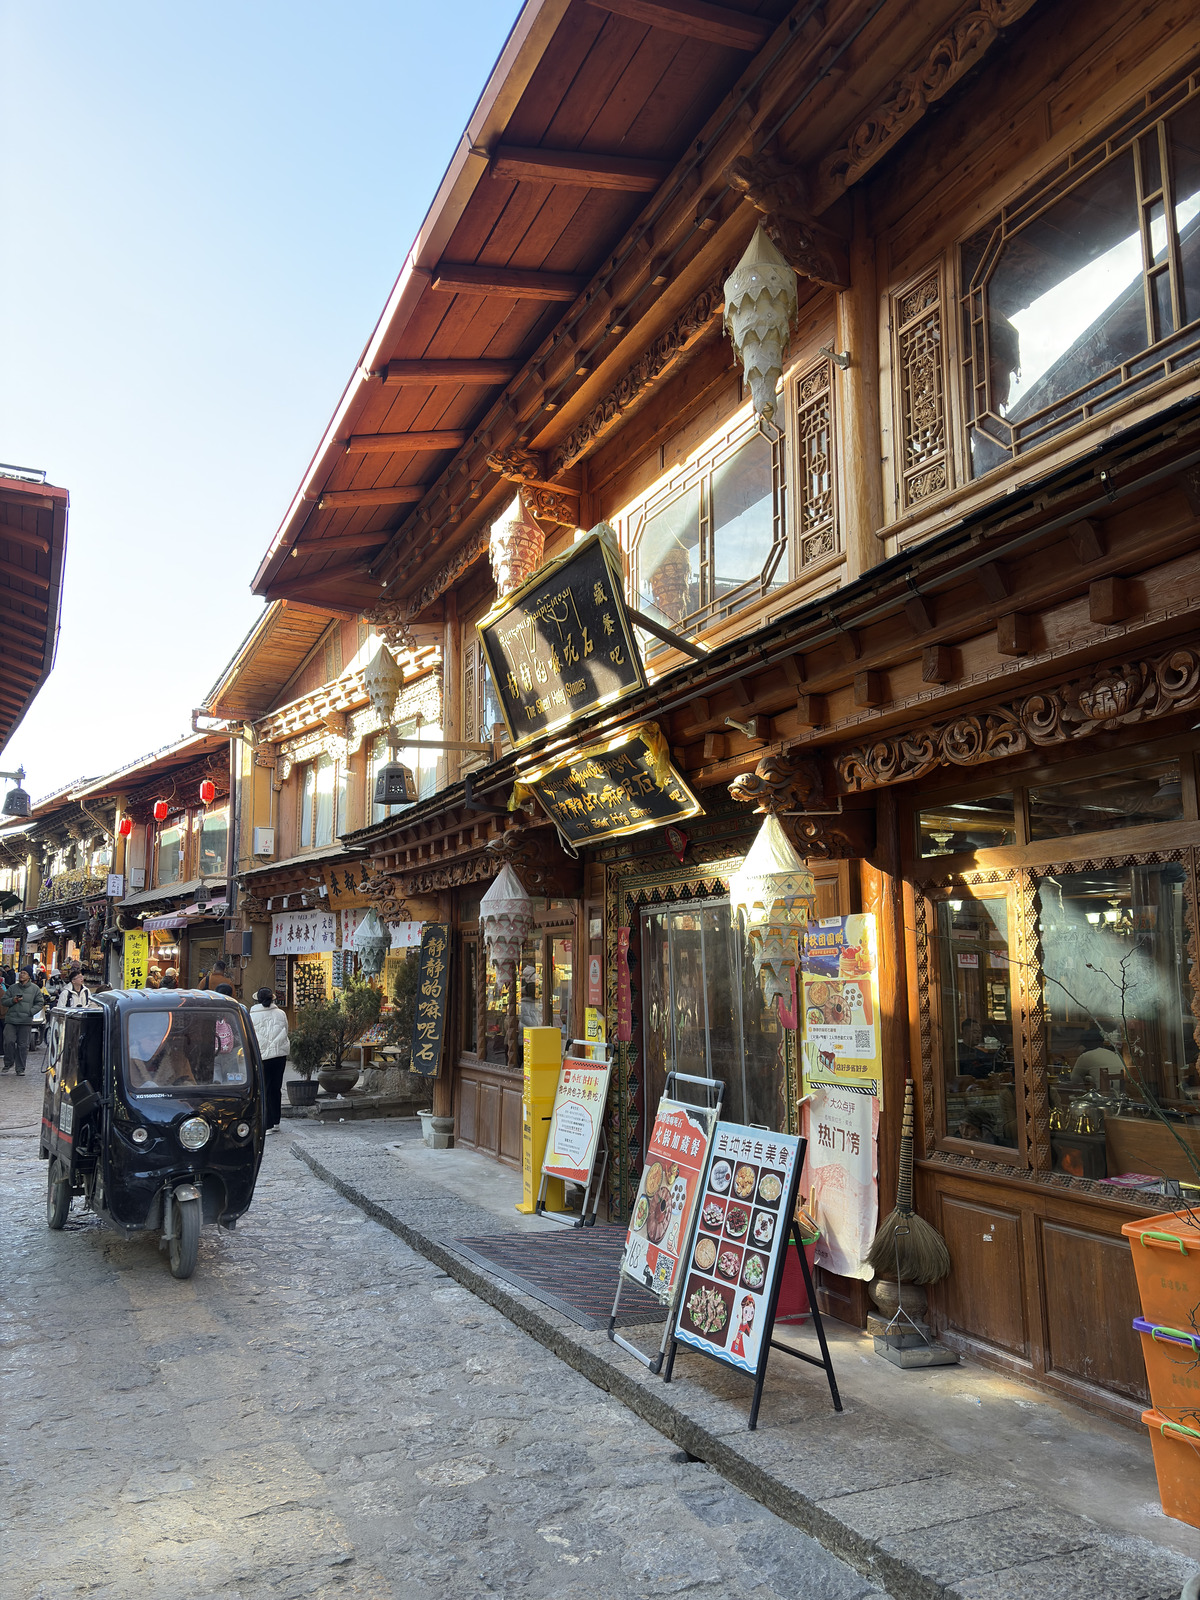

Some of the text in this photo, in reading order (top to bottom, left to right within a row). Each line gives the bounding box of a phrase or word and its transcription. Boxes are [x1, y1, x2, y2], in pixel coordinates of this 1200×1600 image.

[525, 678, 587, 720] The Silent Holy Stones
[416, 937, 446, 1061] 静静的嘛呢石
[830, 1098, 855, 1115] 大众点评
[654, 1126, 700, 1158] 火锅加藏餐
[818, 1122, 860, 1155] 热门榜
